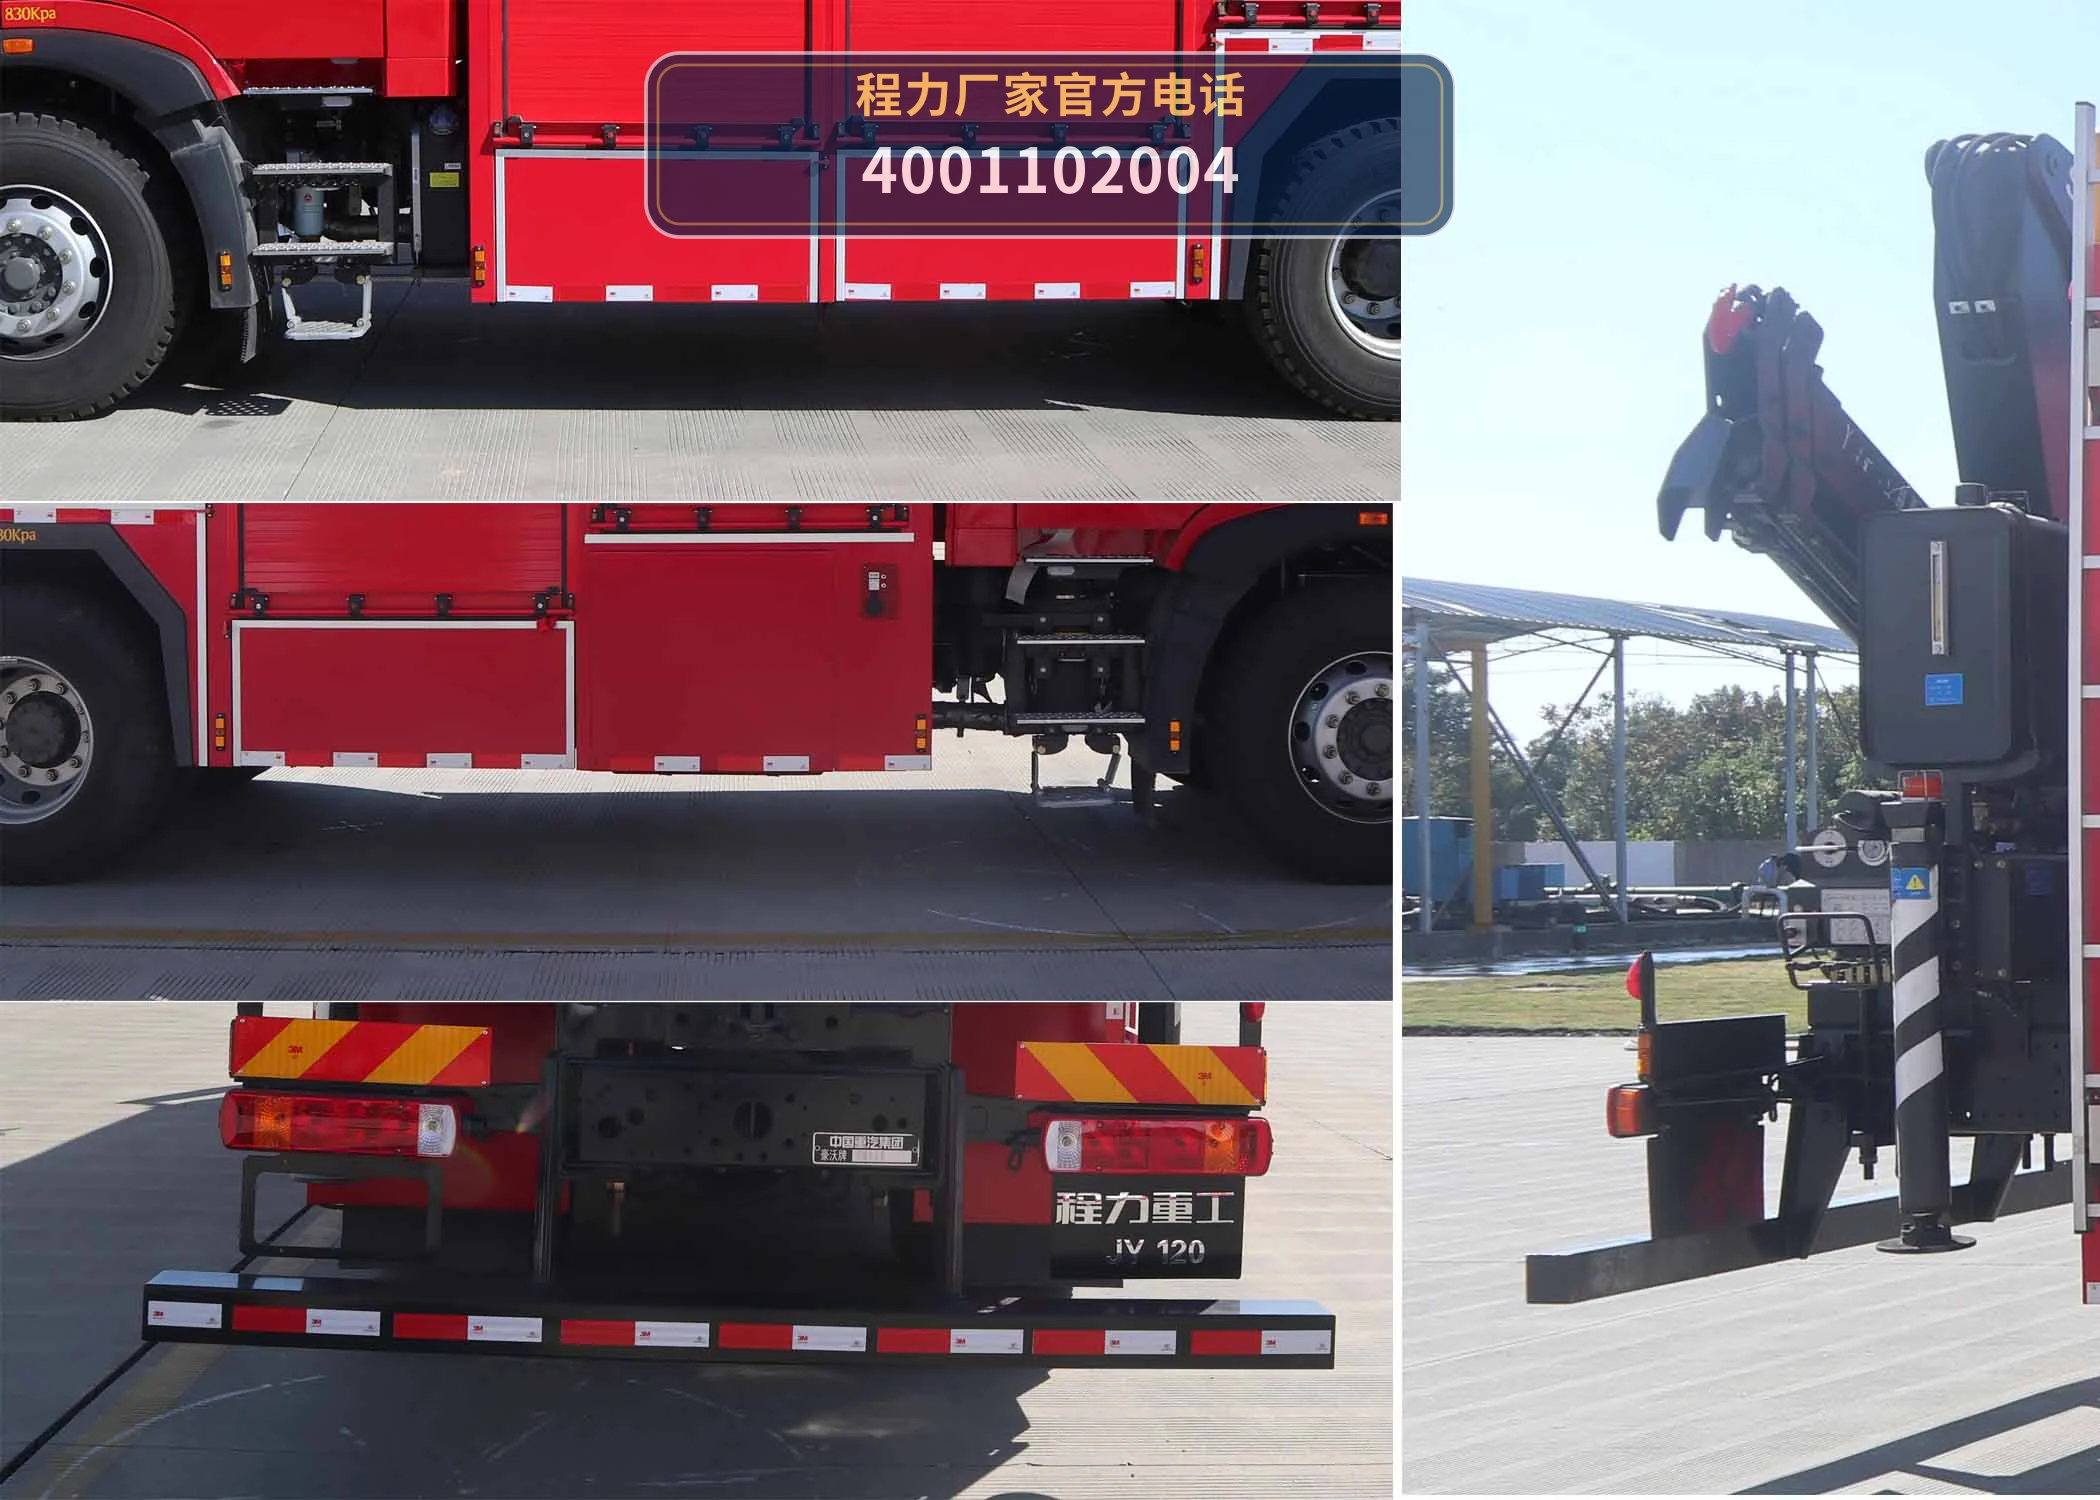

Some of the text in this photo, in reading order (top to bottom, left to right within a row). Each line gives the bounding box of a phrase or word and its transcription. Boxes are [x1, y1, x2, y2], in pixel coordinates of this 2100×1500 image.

[5, 6, 57, 23] 830Kpa
[829, 1135, 904, 1150] 中国重汽集团
[1055, 1191, 1235, 1225] 程力重工
[1105, 1238, 1206, 1265] JY 120
